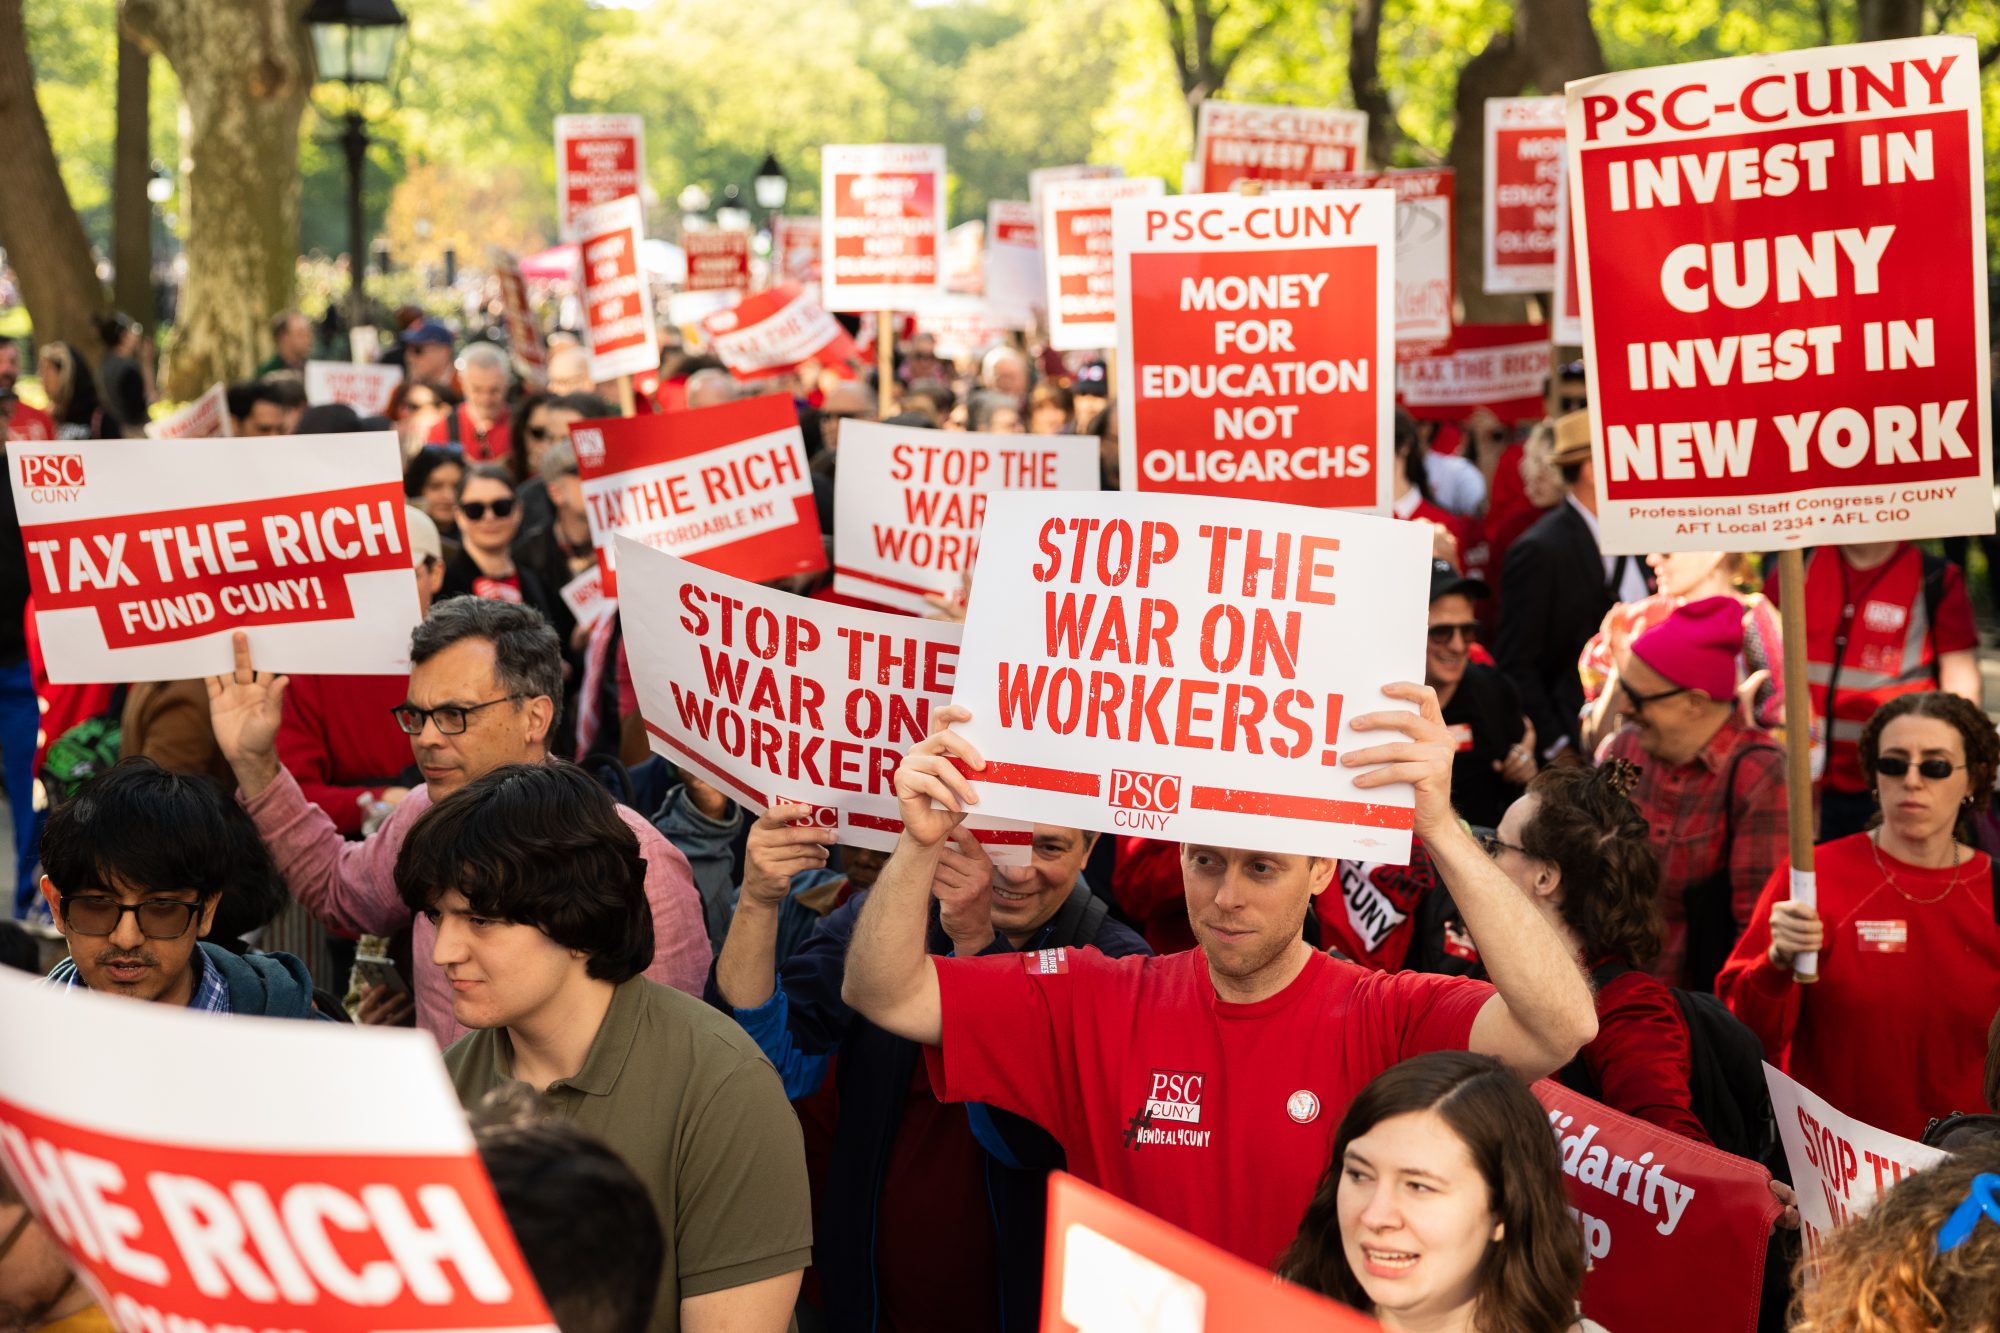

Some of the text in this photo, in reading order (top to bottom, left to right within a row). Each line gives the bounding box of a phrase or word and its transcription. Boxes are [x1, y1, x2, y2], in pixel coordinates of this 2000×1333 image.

[1582, 55, 1958, 141] PSC-CUNY
[1609, 129, 1935, 211] INVEST IN
[1147, 203, 1362, 241] PSC-CUNY
[1180, 272, 1329, 311] MONEY
[1661, 225, 1896, 312] CUNY
[1215, 319, 1295, 355] FOR
[1627, 318, 1935, 391] INVEST IN
[1142, 359, 1368, 398] EDUCATION
[1214, 406, 1299, 440] NOT
[1607, 399, 1972, 481] NEW YORK
[26, 456, 83, 488] PSC
[588, 445, 801, 531] TAX THE RICH
[891, 444, 1058, 489] STOP THE
[1143, 445, 1370, 482] OLIGARCHS
[31, 487, 80, 503] CUNY
[751, 502, 775, 522] NY
[1629, 504, 1742, 519] Professional
[1748, 500, 1792, 515] Staff
[1796, 492, 1885, 512] Congress
[1902, 486, 1957, 503] CUNY
[28, 501, 402, 593] TAX THE RICH
[1676, 508, 1910, 535] AFT Local 2334 AFL CIO
[1032, 517, 1340, 606] STOP THE
[119, 577, 326, 635] FUND CUNY!
[679, 582, 960, 694] STOP THE
[1045, 591, 1302, 679] WAR ON
[699, 644, 930, 745] WAR ON
[998, 661, 1344, 768] WORKERS!
[1111, 772, 1179, 812] PSC
[1114, 810, 1170, 832] CUNY
[1343, 867, 1397, 943] CUNY
[1149, 1073, 1202, 1104] PSC
[1151, 1102, 1194, 1120] CUNY
[1797, 1105, 1858, 1200] STOP
[145, 1172, 512, 1306] RICH
